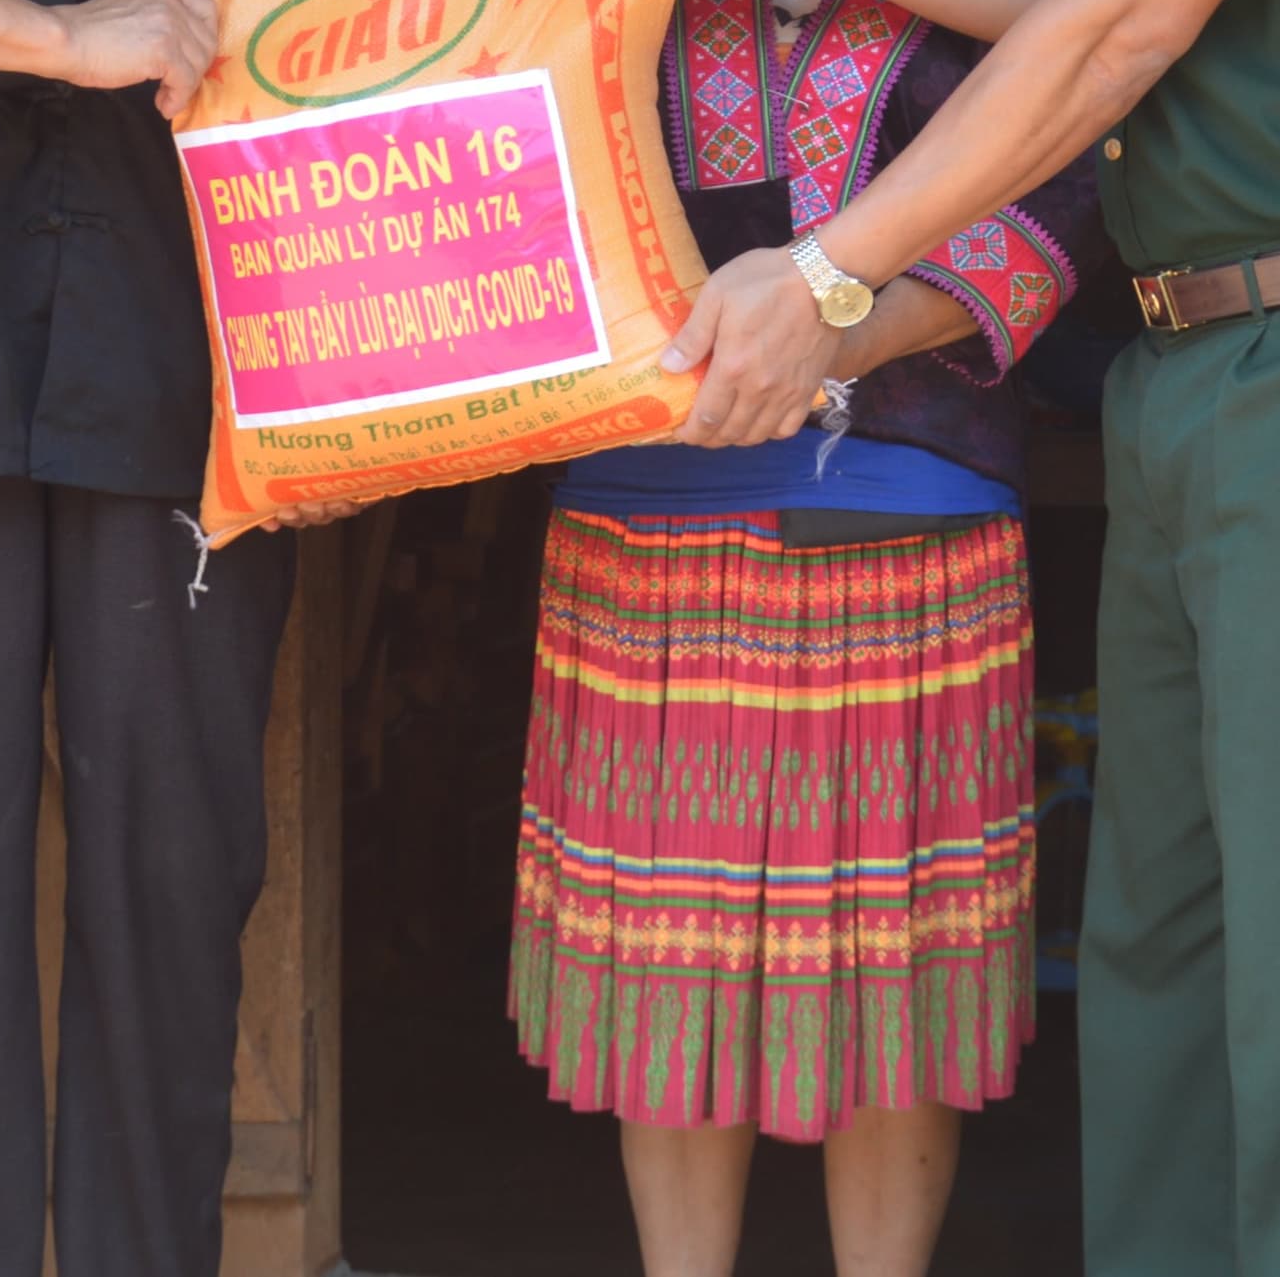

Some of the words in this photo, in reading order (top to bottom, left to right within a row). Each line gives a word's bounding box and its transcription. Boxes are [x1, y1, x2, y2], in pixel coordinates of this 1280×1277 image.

[209, 167, 302, 225] BINH
[309, 134, 453, 209] ĐOÀN
[466, 125, 522, 177] 16
[613, 113, 680, 319] THƠM
[230, 239, 273, 279] BAN
[274, 222, 344, 274] QUẢN
[345, 212, 376, 261] LÝ
[382, 211, 424, 258] DỰ
[433, 196, 471, 245] ÁN
[475, 191, 521, 234] 174
[226, 312, 280, 372] CHUNG
[274, 307, 311, 366] TAY
[348, 281, 389, 354] LÙI
[383, 288, 426, 360] ĐẠI
[421, 277, 480, 354] DỊCH
[476, 256, 575, 331] COVID-19
[257, 427, 354, 452] Hương
[362, 411, 456, 443] Thơm
[465, 388, 522, 421] Bát
[549, 411, 646, 448] 25KG
